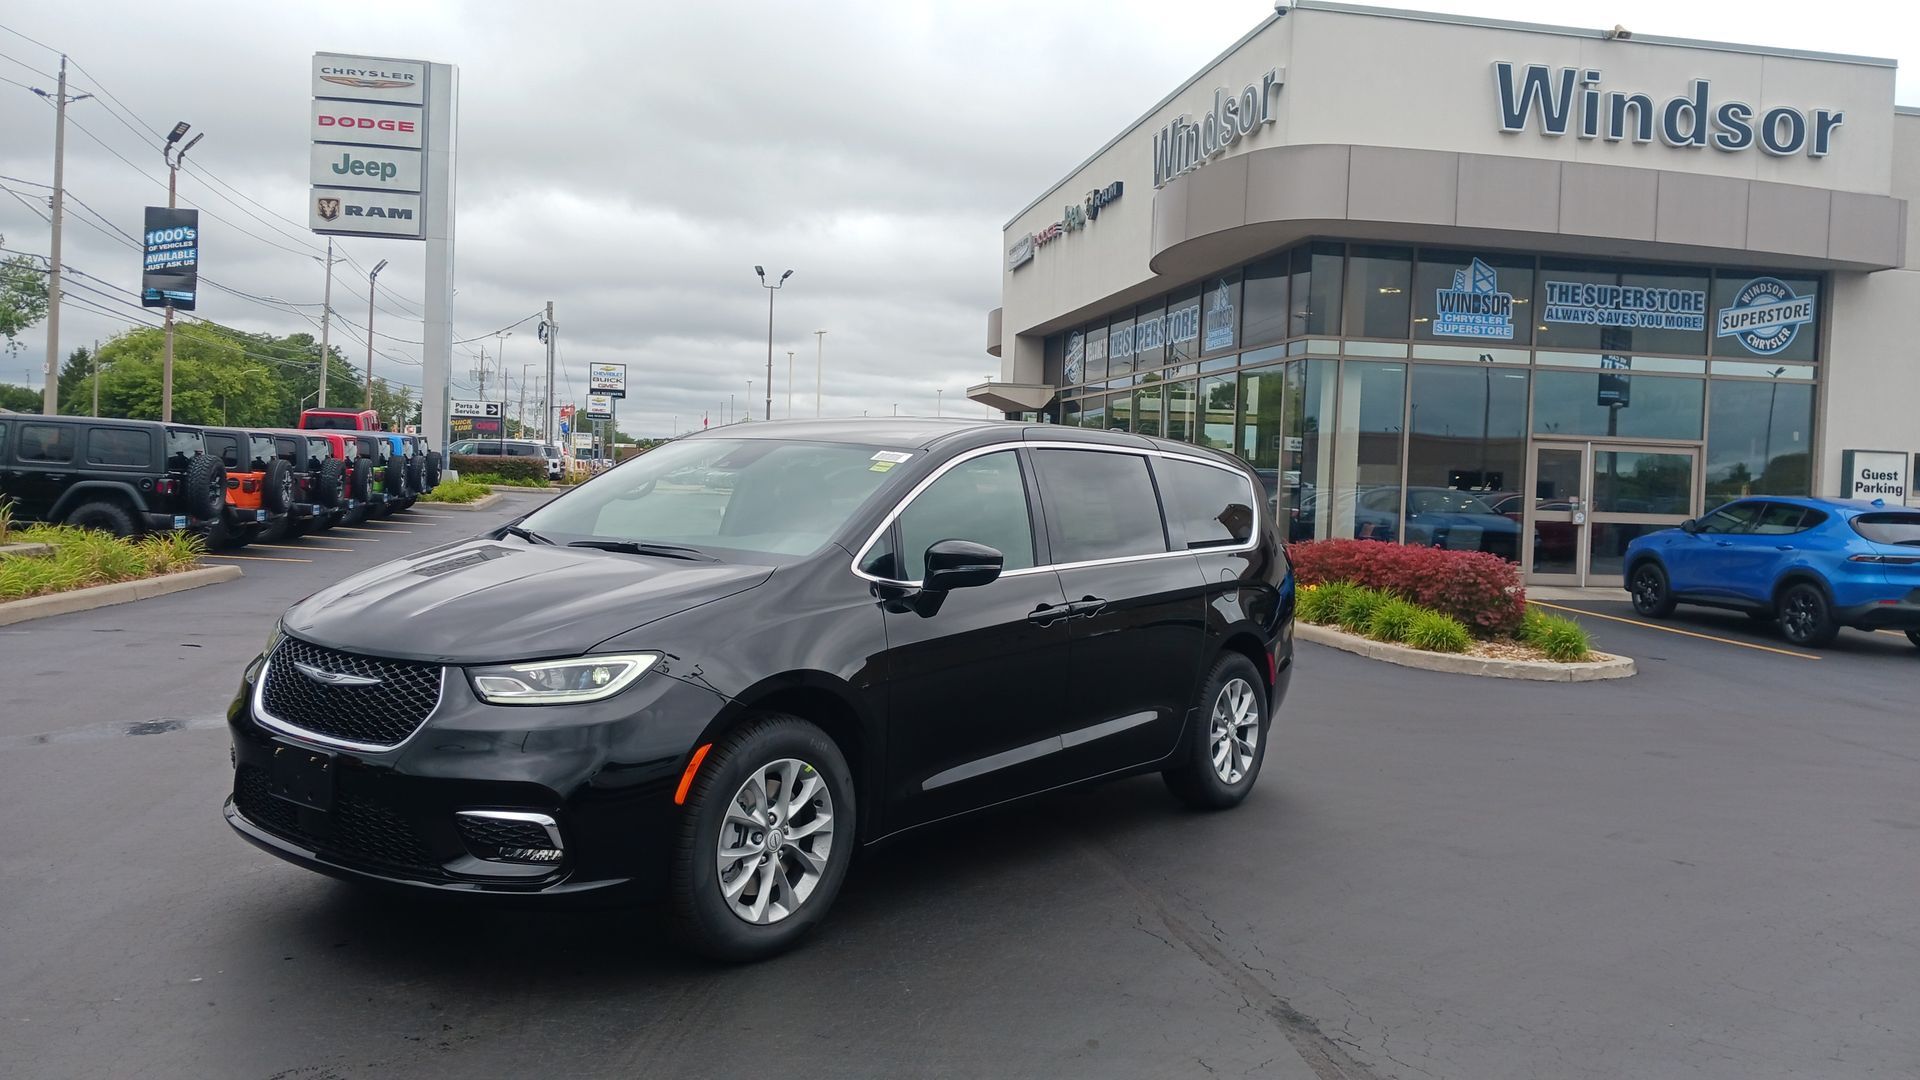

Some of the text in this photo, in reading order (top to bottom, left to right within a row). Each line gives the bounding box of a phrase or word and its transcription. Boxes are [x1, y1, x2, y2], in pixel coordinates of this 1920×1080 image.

[321, 67, 414, 80] CHRYSLER
[1492, 60, 1844, 157] Windsor
[318, 115, 414, 133] DODGE
[1152, 68, 1285, 189] Windsor
[332, 153, 397, 181] Jeep
[1094, 181, 1124, 208] RAM
[344, 205, 412, 220] RAM
[146, 227, 195, 245] 1000's
[159, 241, 193, 250] VEHICLES
[146, 249, 196, 264] AVAILABLE
[146, 262, 165, 271] JUST
[166, 260, 182, 268] ASK
[1546, 282, 1704, 312] THE SUPERSTORE
[1741, 283, 1786, 303] WINDSOR
[1439, 291, 1511, 316] WINDSOR
[1445, 313, 1503, 325] CHRYSLER
[1545, 307, 1703, 329] ALWAYS SAVES YOU MORE!
[1722, 303, 1810, 329] SUPERSTORE
[1123, 305, 1199, 357] SUPERSTORE
[1436, 323, 1511, 336] SUPERSTORE
[1747, 327, 1791, 350] CHRYSLER
[1861, 468, 1898, 481] Guest
[1855, 481, 1903, 497] Parking
